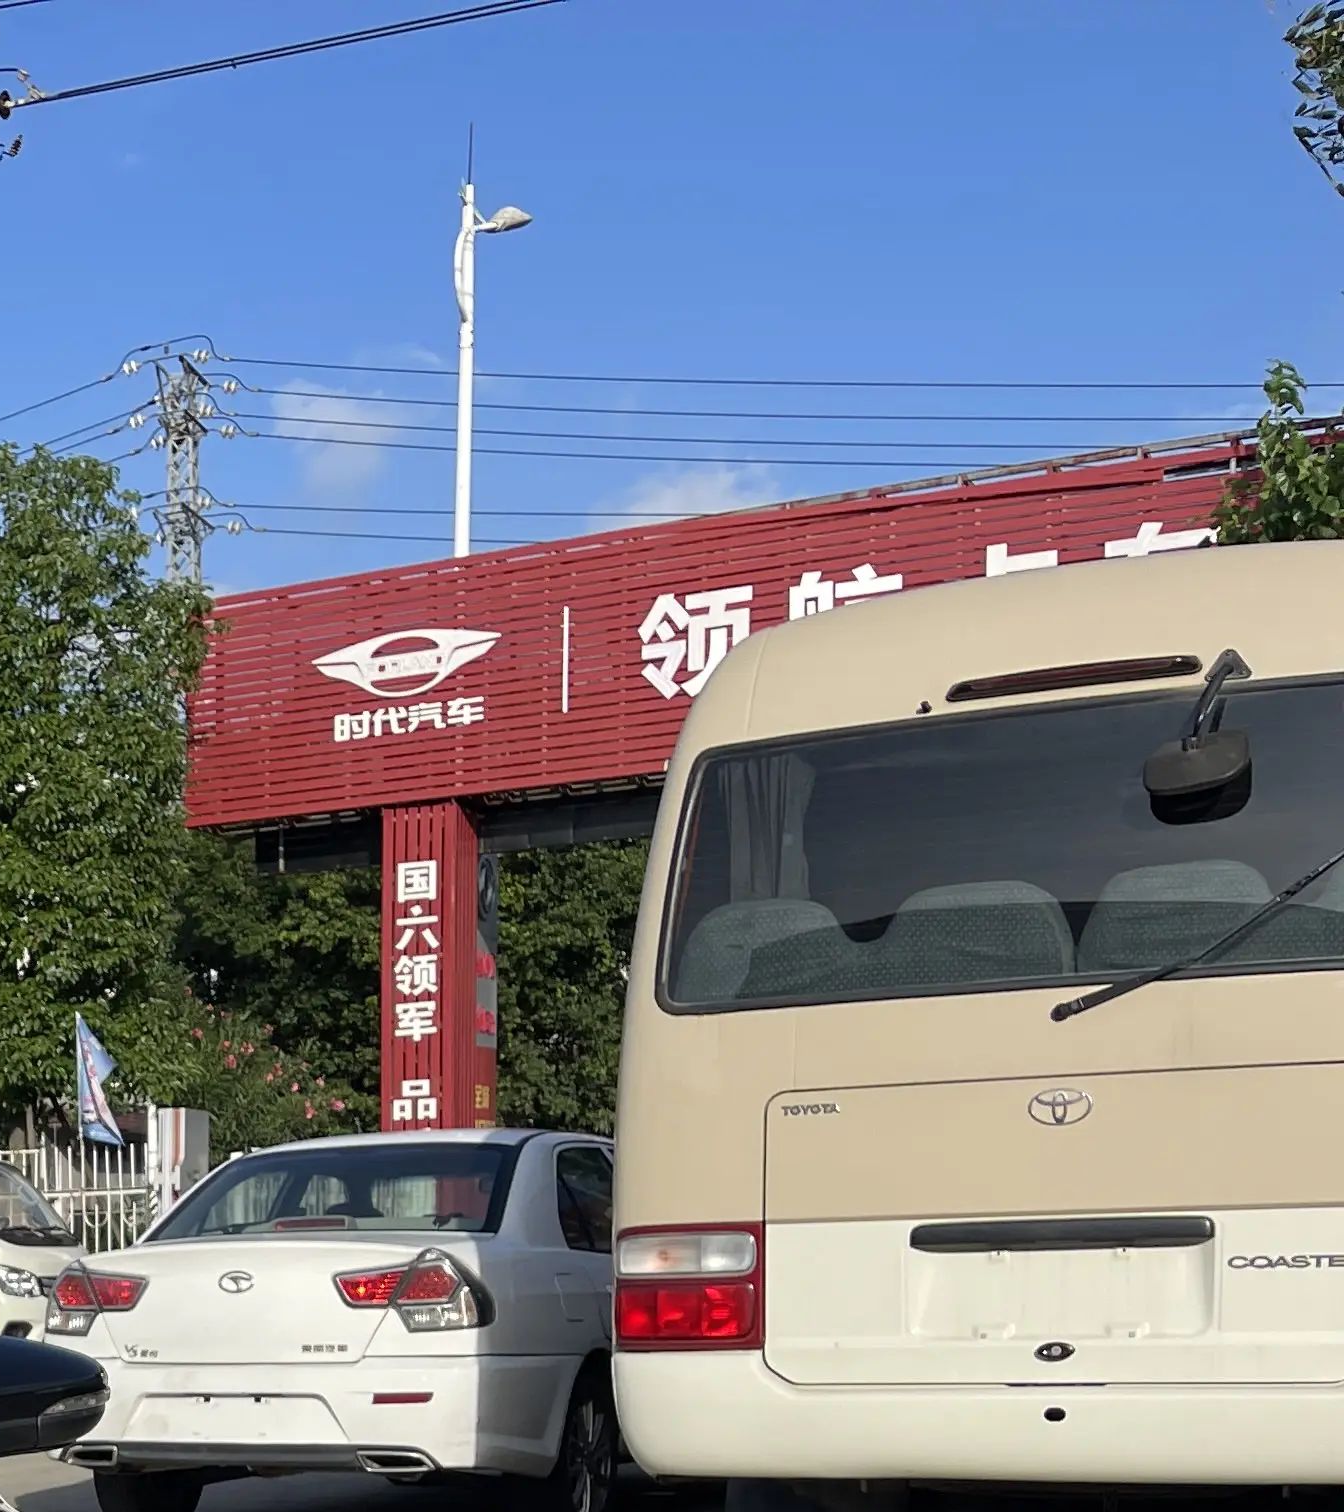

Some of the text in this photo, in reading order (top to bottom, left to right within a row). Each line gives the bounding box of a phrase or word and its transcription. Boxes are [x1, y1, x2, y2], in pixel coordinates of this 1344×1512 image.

[334, 696, 484, 742] 时代汽车
[392, 860, 440, 1122] 国六领军 品
[781, 1103, 840, 1116] TOYOTA
